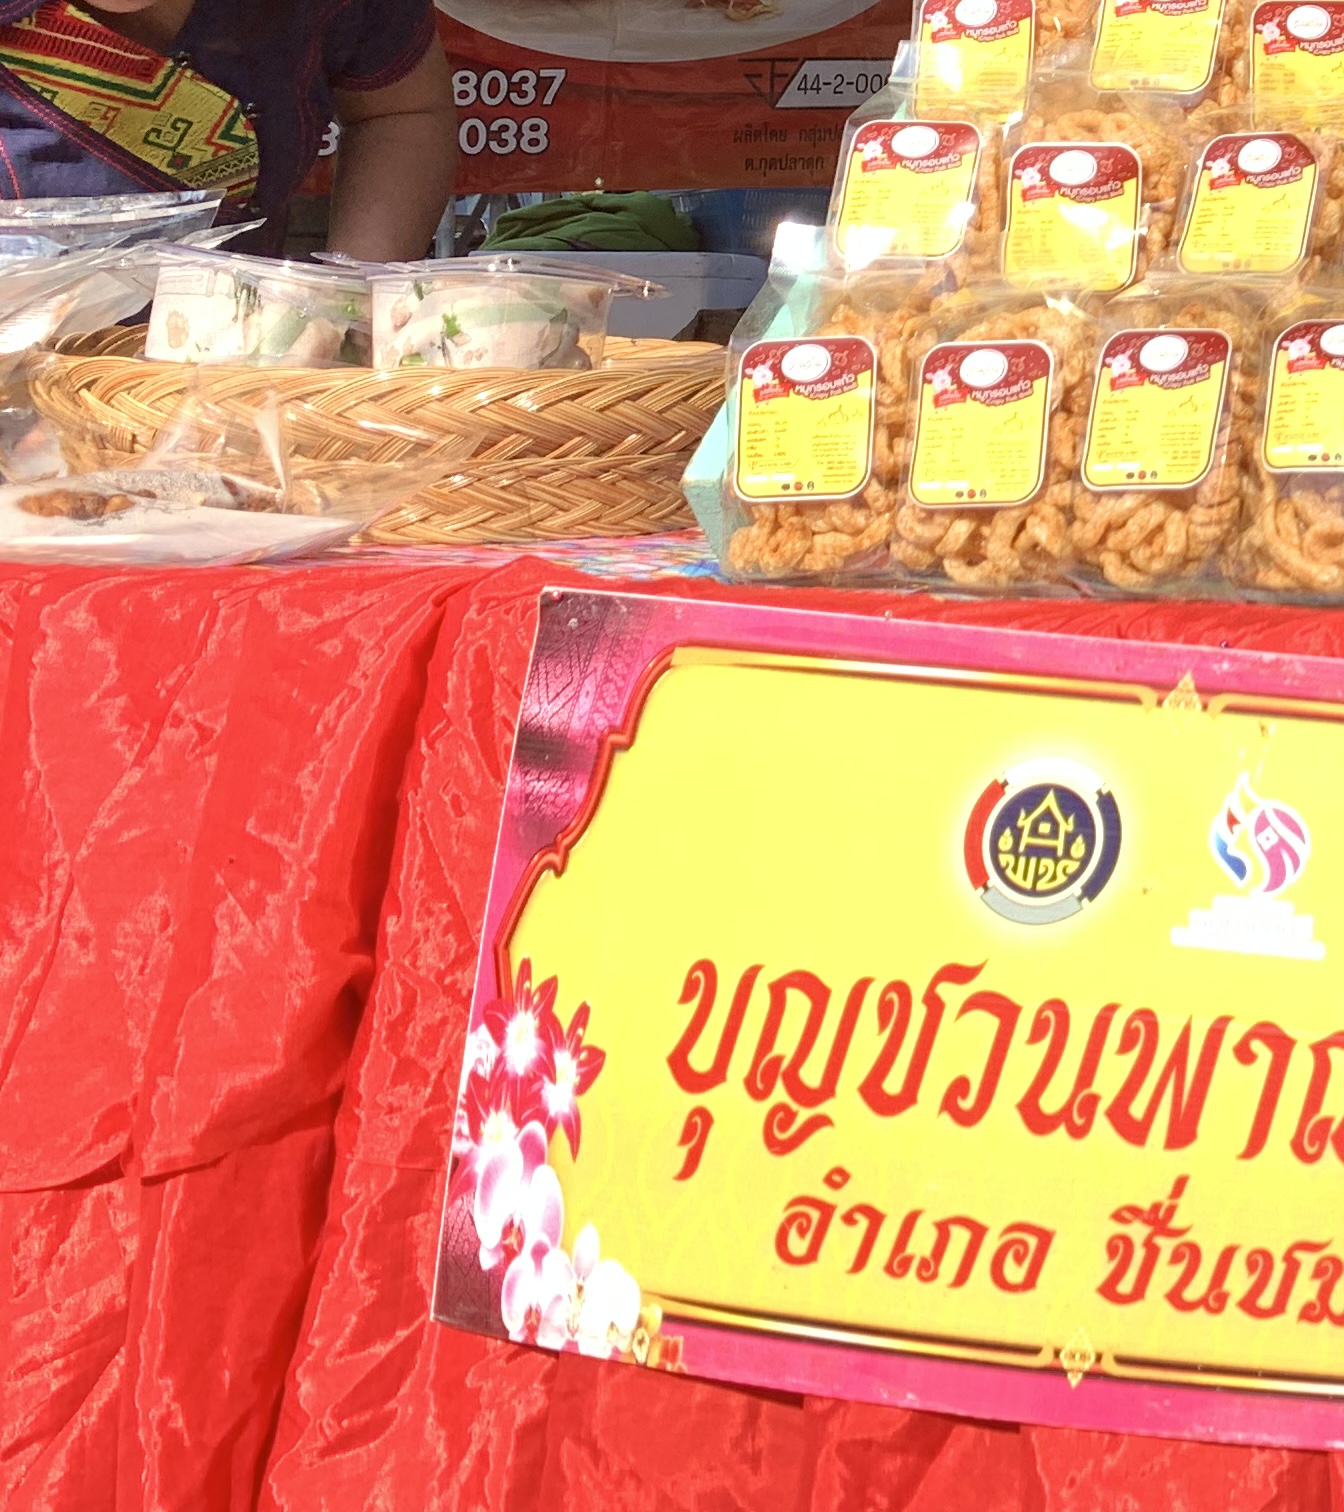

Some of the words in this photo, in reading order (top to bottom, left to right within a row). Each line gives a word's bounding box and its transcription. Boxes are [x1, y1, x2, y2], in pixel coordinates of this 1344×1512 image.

[452, 69, 566, 106] 8037
[797, 73, 889, 95] 44-2-00
[458, 117, 549, 155] 038
[733, 122, 788, 144] ผลิตโดย
[773, 1165, 1057, 1294] อำเภอ
